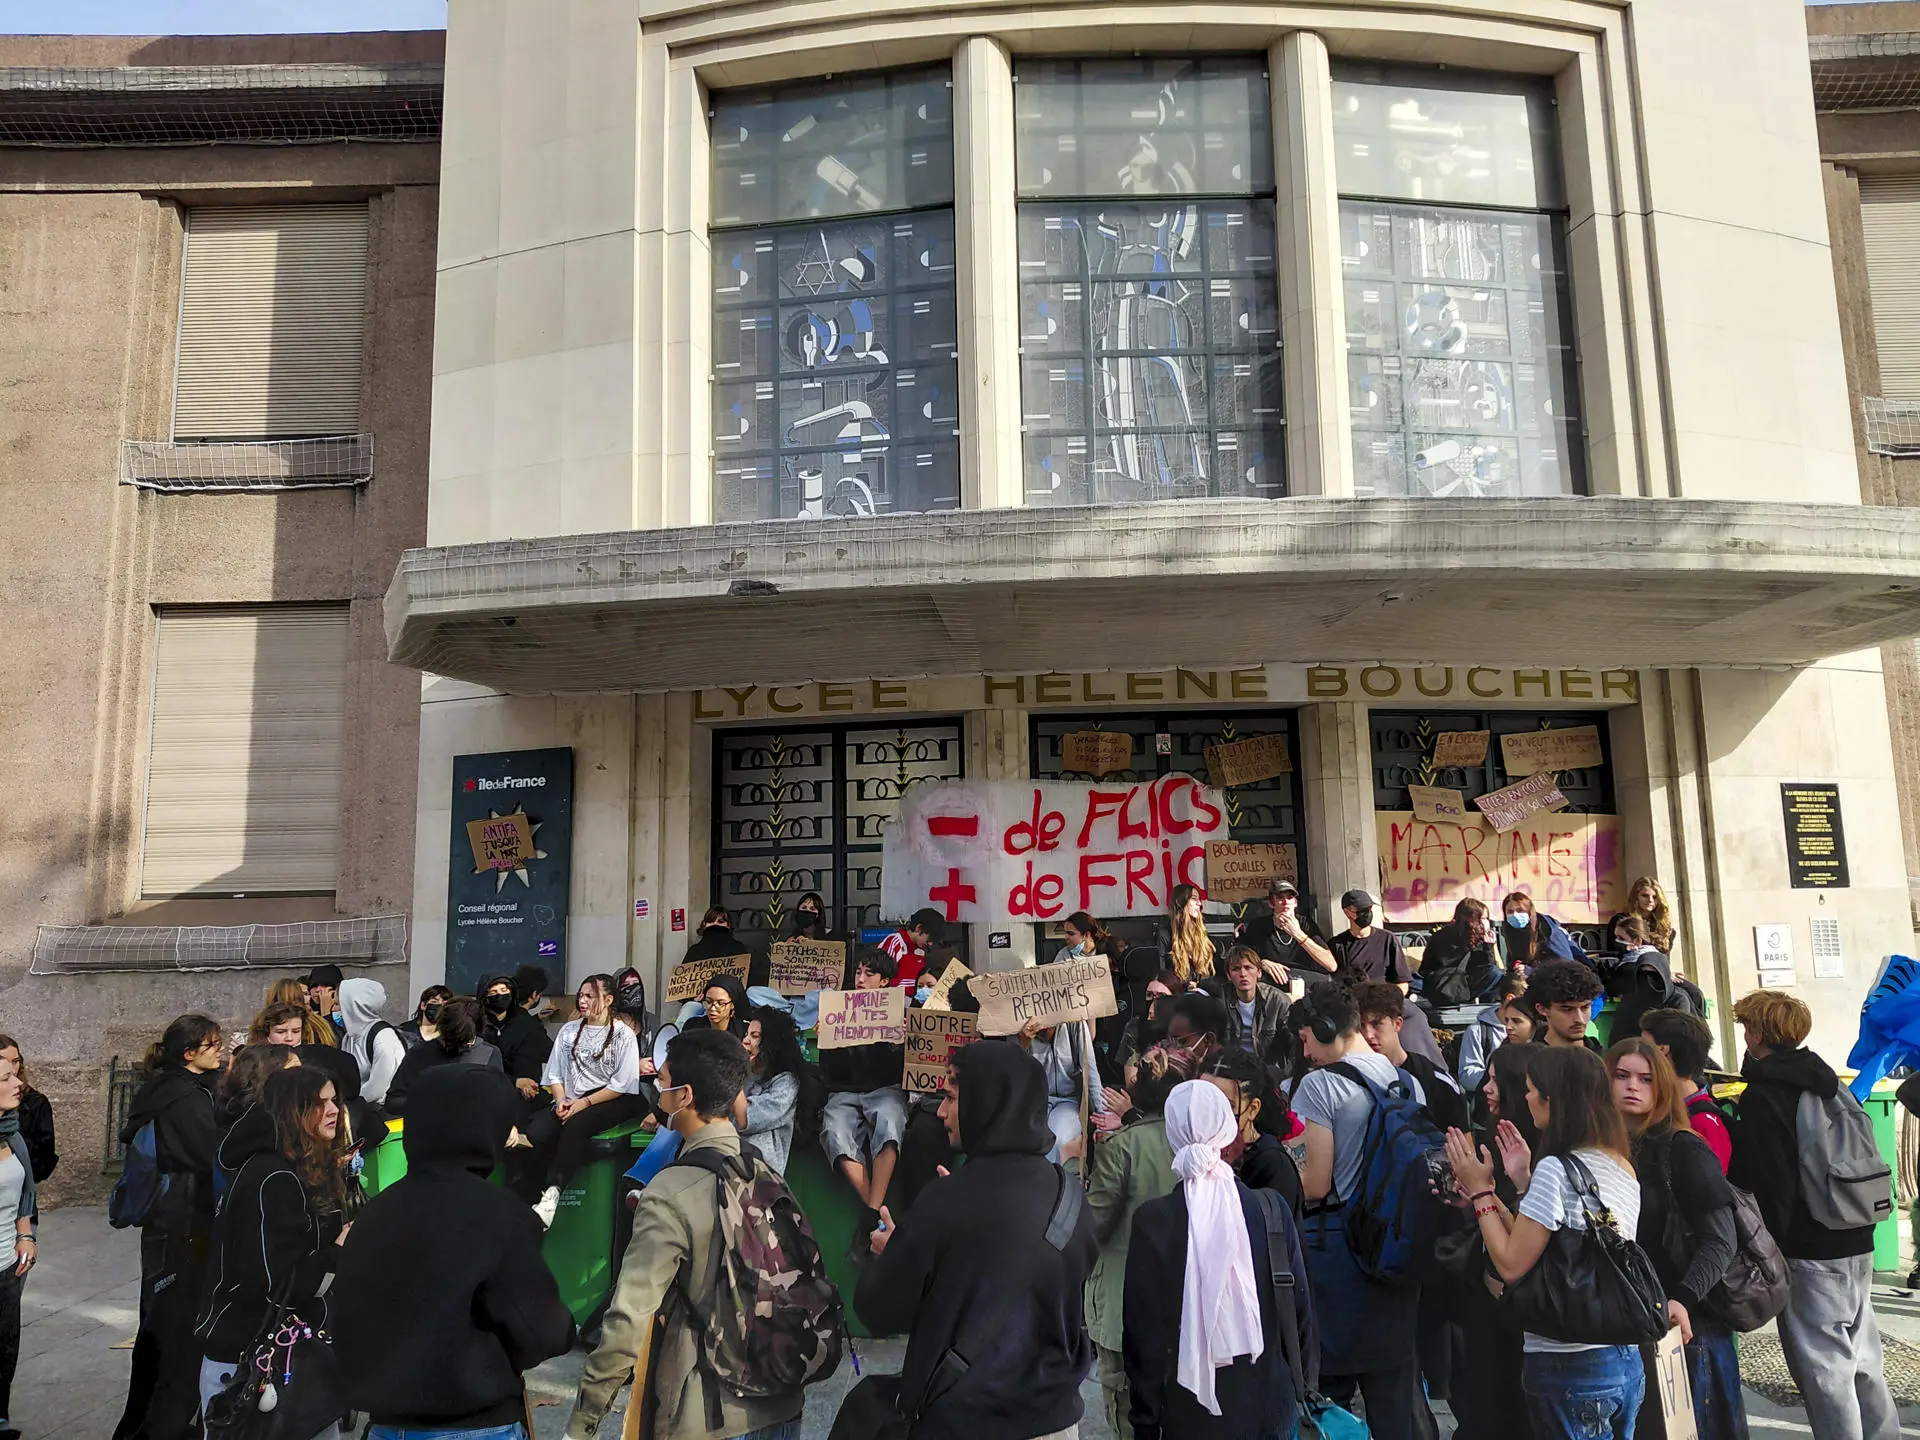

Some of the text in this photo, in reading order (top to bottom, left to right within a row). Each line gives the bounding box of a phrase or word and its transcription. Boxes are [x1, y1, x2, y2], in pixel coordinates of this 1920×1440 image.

[1307, 666, 1638, 699] BOUCHER
[1003, 788, 1066, 856] de
[1077, 777, 1222, 848] FLICS
[483, 822, 519, 839] ANTIFA
[485, 849, 496, 860] LA
[1212, 843, 1288, 858] BOUFFE MES
[1390, 822, 1574, 886] MARINE
[1272, 859, 1293, 871] PAS
[1008, 861, 1064, 919] de
[1213, 876, 1241, 891] MON
[458, 902, 518, 914] Conseil régional
[457, 916, 524, 926] Lycée Hélène Boucher
[771, 945, 786, 956] LES
[1764, 953, 1789, 963] PARIS
[692, 957, 737, 973] MANQUE
[783, 955, 811, 966] SONT
[670, 973, 688, 985] NOS
[988, 974, 1039, 997] SOUTIEN
[1041, 969, 1058, 988] AUX
[844, 990, 889, 1010] MARINE
[825, 1009, 889, 1026] ON A TES
[910, 1013, 972, 1034] NOTRE
[833, 1026, 906, 1042] MENOTTES
[907, 1037, 934, 1052] NOS
[905, 1070, 937, 1090] NOS
